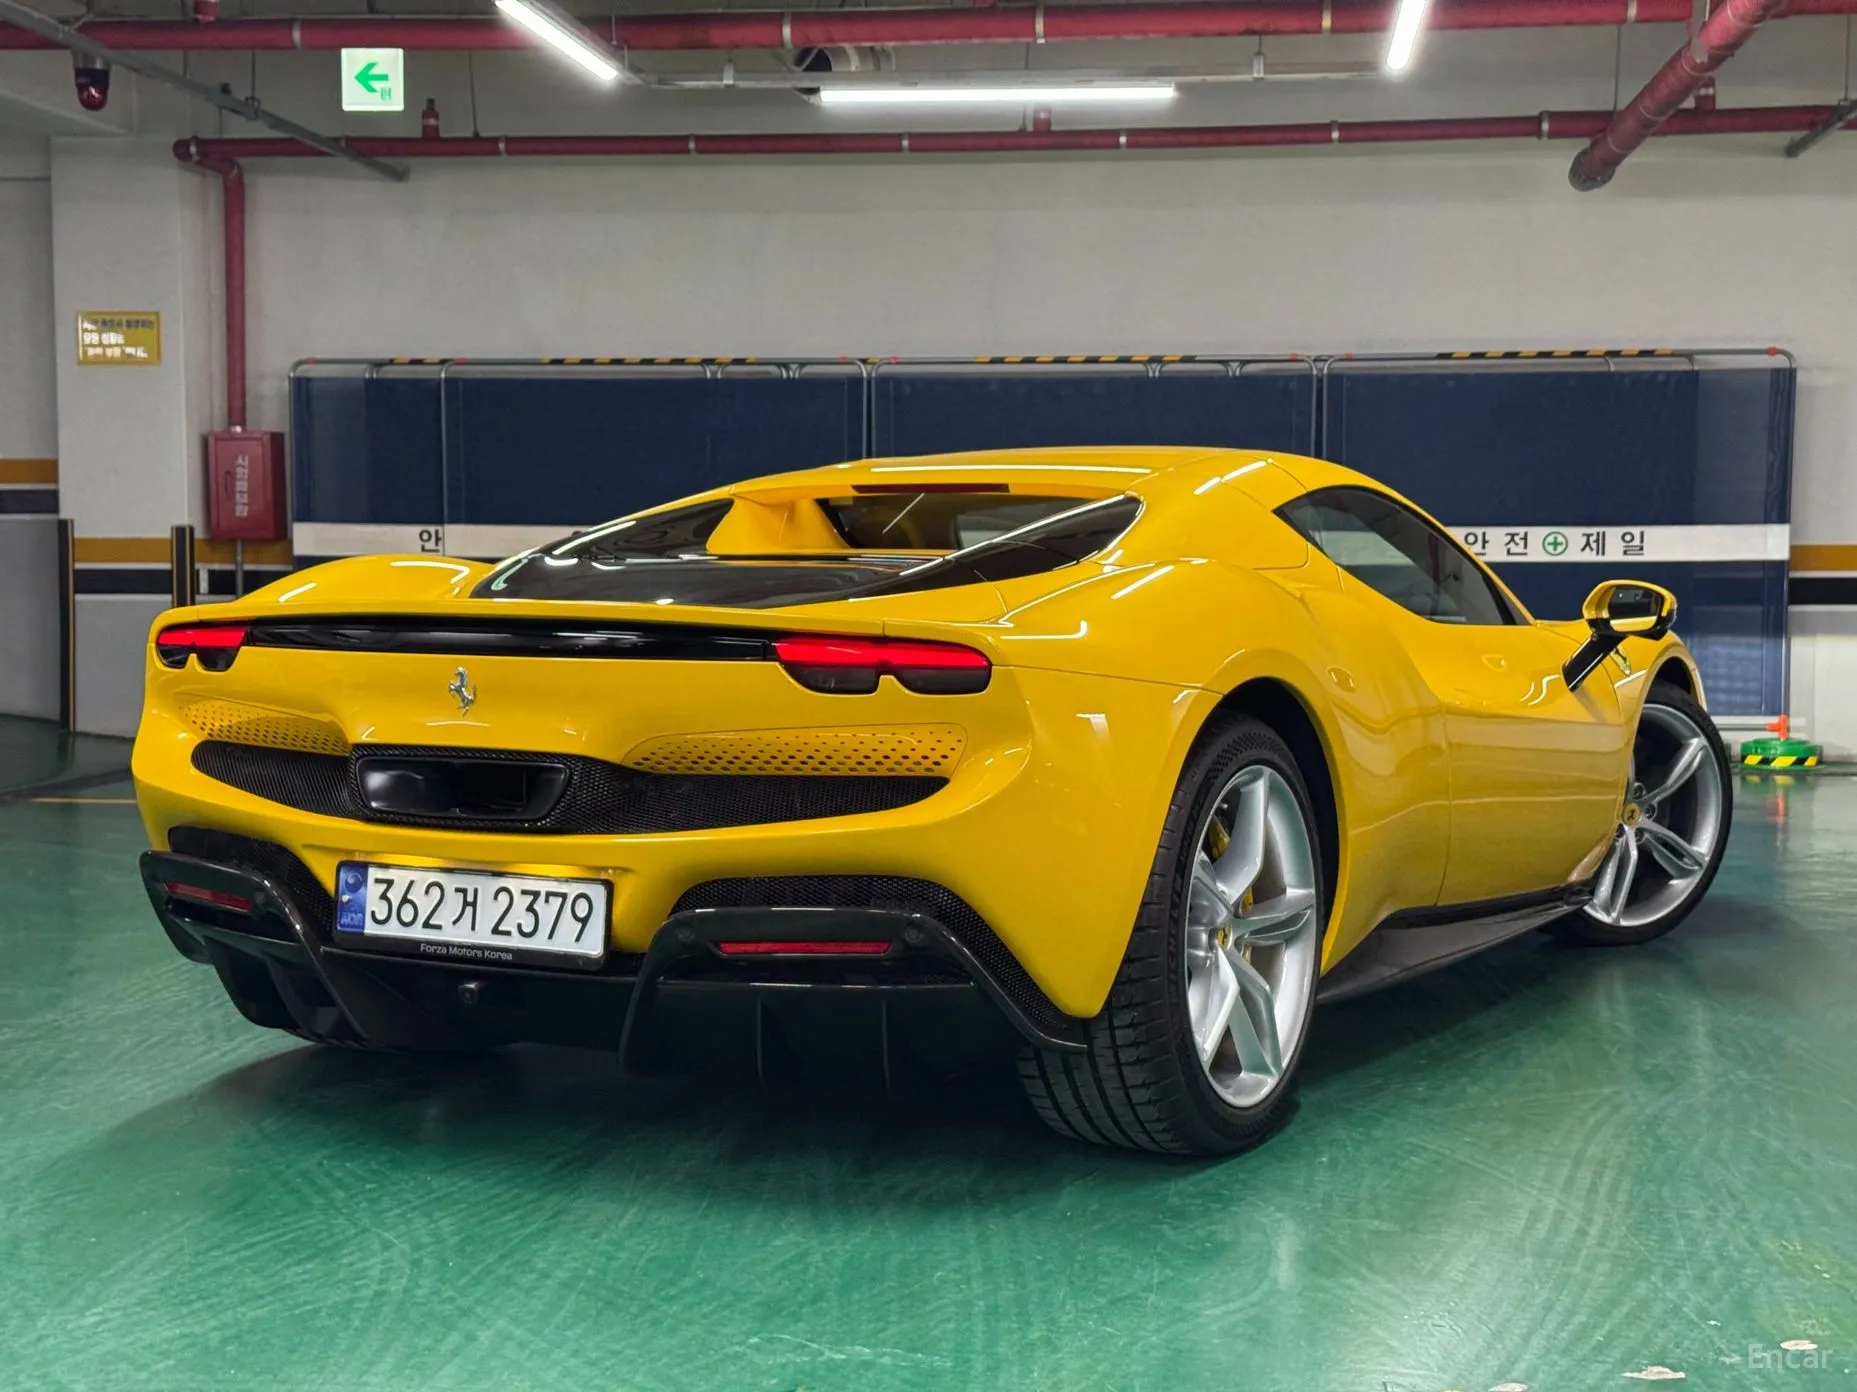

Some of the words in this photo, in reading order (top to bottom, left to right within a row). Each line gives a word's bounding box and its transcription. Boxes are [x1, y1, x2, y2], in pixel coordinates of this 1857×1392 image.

[419, 529, 442, 553] 안
[1580, 531, 1646, 556] 제일
[370, 877, 479, 931] 362거
[491, 886, 594, 943] 2379
[420, 943, 447, 954] Forza
[449, 946, 483, 958] Motors
[484, 949, 513, 960] Korea
